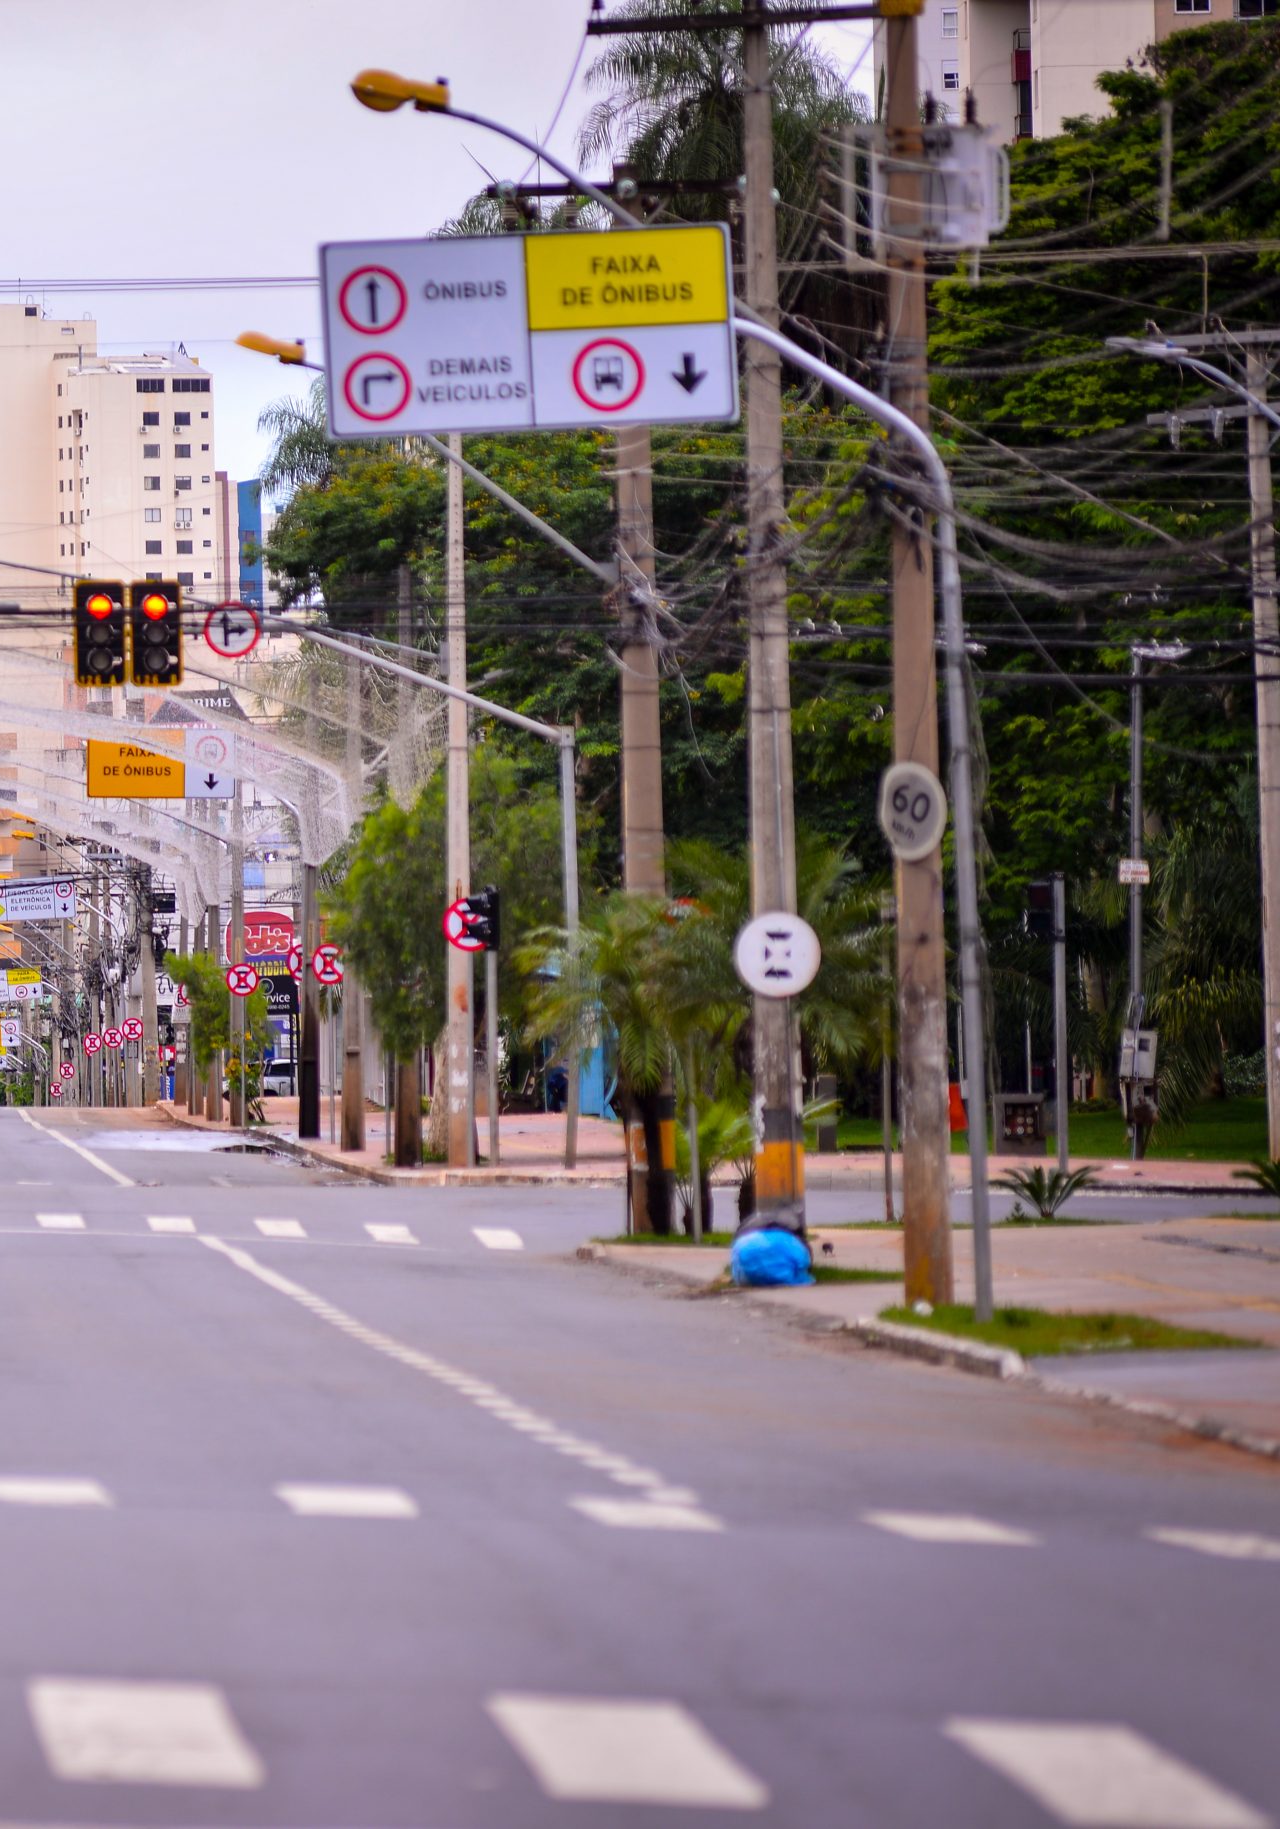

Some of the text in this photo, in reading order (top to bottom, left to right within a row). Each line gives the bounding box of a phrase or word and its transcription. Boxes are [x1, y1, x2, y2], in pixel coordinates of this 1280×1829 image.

[590, 254, 661, 275] FAIXA
[424, 279, 508, 301] ÔNIBUS
[561, 281, 695, 307] DE ÔNIBUS
[428, 356, 513, 376] DEMAIS
[418, 380, 528, 403] VEÍCULOS
[191, 697, 231, 708] RIME
[119, 747, 156, 757] FAIXA
[103, 763, 172, 776] DE ÔNIBUS
[892, 784, 931, 823] 60
[10, 896, 51, 904] ELETRÔNICA
[20, 903, 52, 912] VEÍCULOS
